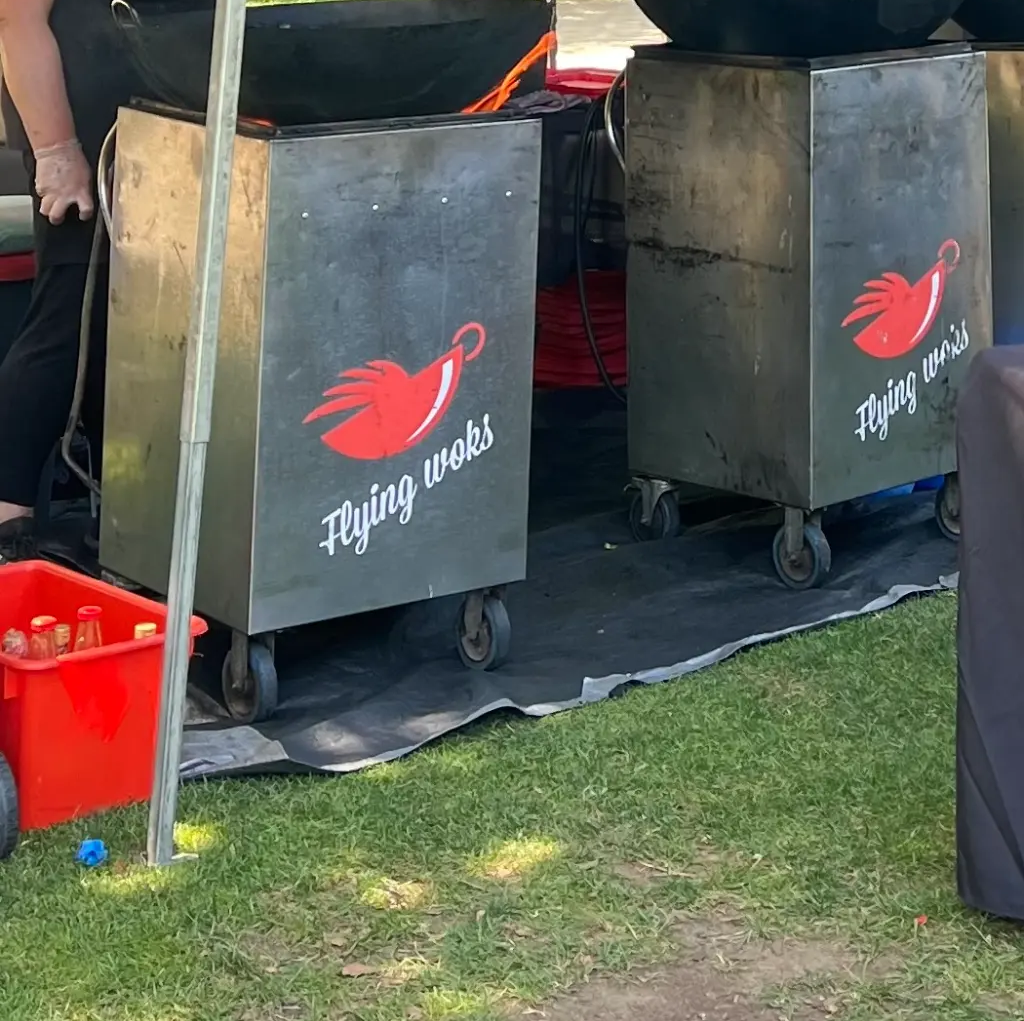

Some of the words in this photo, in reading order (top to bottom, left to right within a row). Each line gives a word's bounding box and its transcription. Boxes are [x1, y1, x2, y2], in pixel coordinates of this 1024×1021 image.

[854, 370, 917, 442] Flying
[318, 474, 418, 556] Flying
[424, 413, 494, 489] woks
